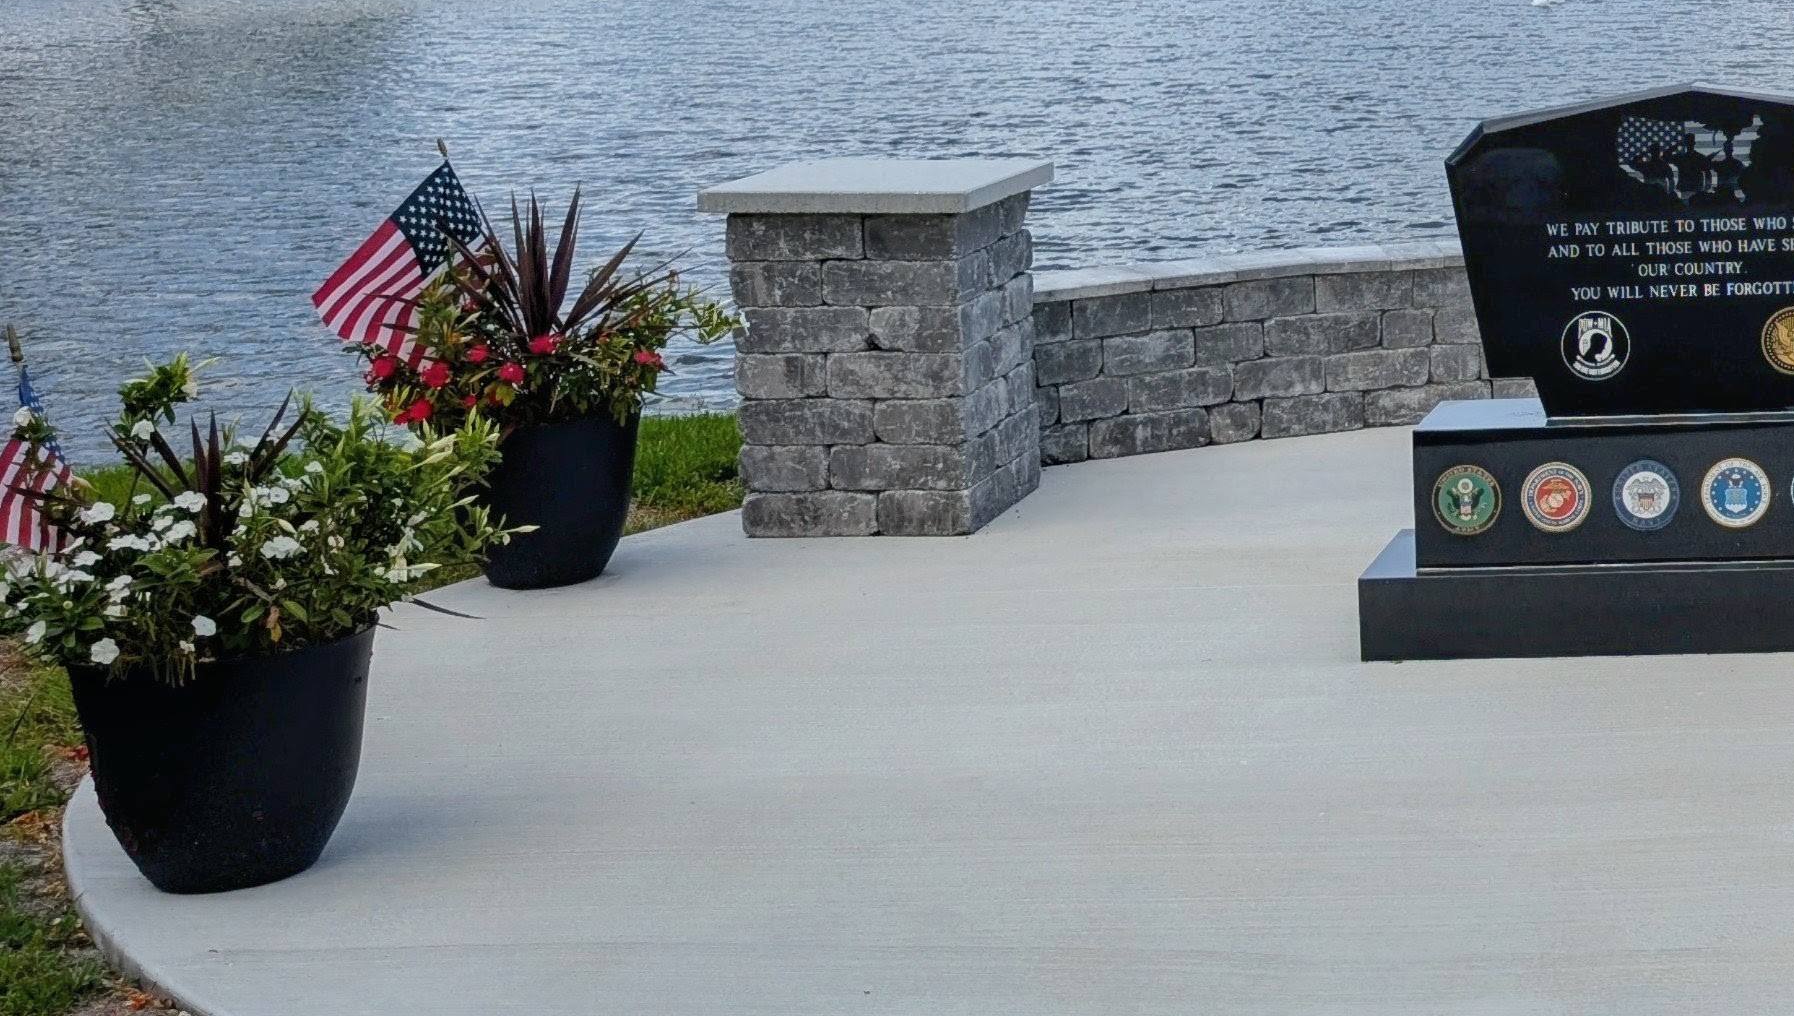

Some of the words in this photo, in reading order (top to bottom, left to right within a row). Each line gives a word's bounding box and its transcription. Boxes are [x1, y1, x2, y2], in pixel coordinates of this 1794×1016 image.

[1546, 223, 1569, 237] WE
[1575, 222, 1600, 236] PAY
[1605, 220, 1669, 235] TRIBUTE
[1674, 219, 1695, 233] TO
[1700, 218, 1747, 232] THOSE
[1753, 216, 1787, 230] WHO
[1548, 244, 1580, 258] AND
[1585, 243, 1605, 257] TO
[1611, 242, 1640, 256] ALL
[1646, 241, 1693, 255] THOSE
[1698, 240, 1732, 253] WHO
[1738, 238, 1776, 252] HAVE
[1638, 263, 1668, 277] OUR
[1571, 287, 1601, 300] YOU
[1607, 285, 1644, 299] WILL
[1650, 284, 1698, 298] NEVER
[1703, 283, 1721, 297] BE
